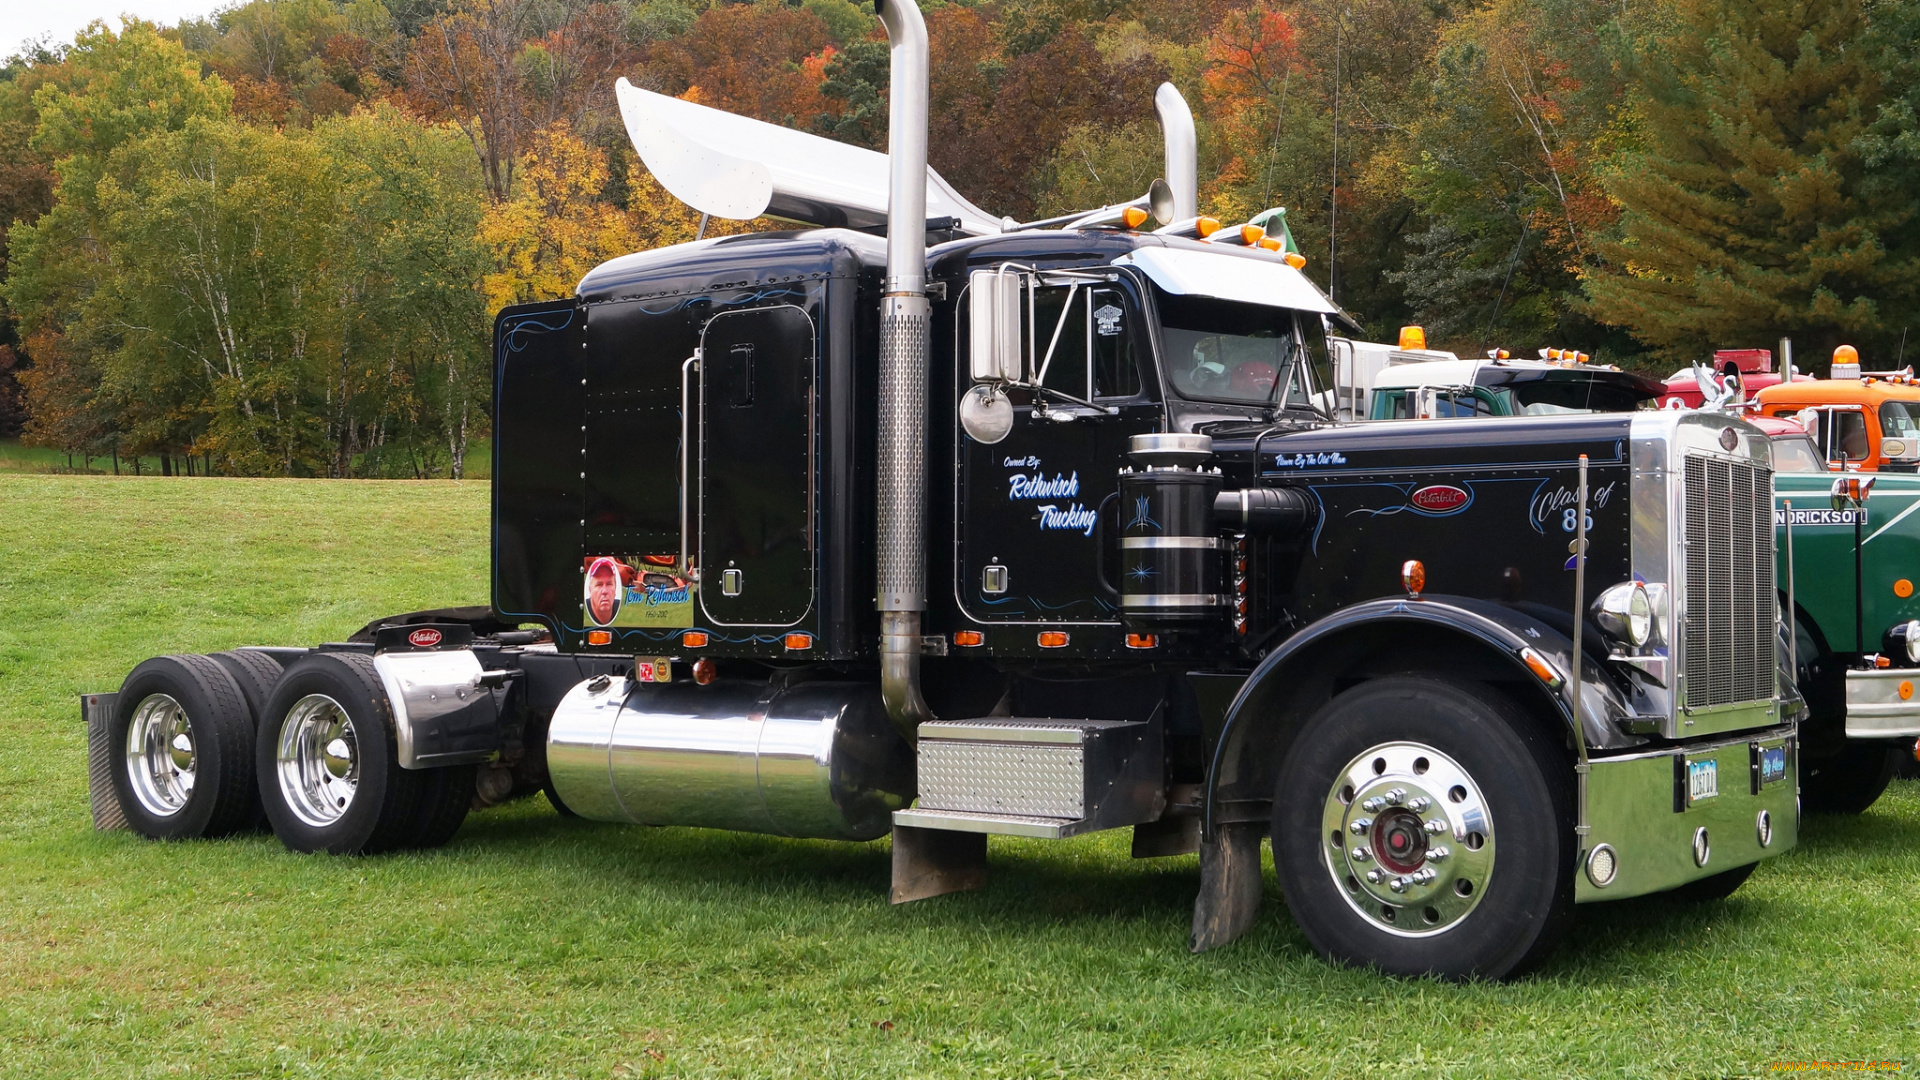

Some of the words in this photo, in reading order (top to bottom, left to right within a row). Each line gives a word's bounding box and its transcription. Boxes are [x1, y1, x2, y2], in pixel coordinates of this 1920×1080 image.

[1003, 456, 1027, 468] Owned
[1294, 453, 1306, 469] By
[1306, 453, 1317, 465] The
[1317, 452, 1330, 465] Old
[1330, 452, 1347, 465] Man
[1009, 470, 1079, 501] Rethwisch
[1593, 481, 1616, 508] of
[1418, 490, 1462, 504] Peterbilt
[1037, 502, 1098, 537] Trucking
[624, 585, 644, 607] Tom
